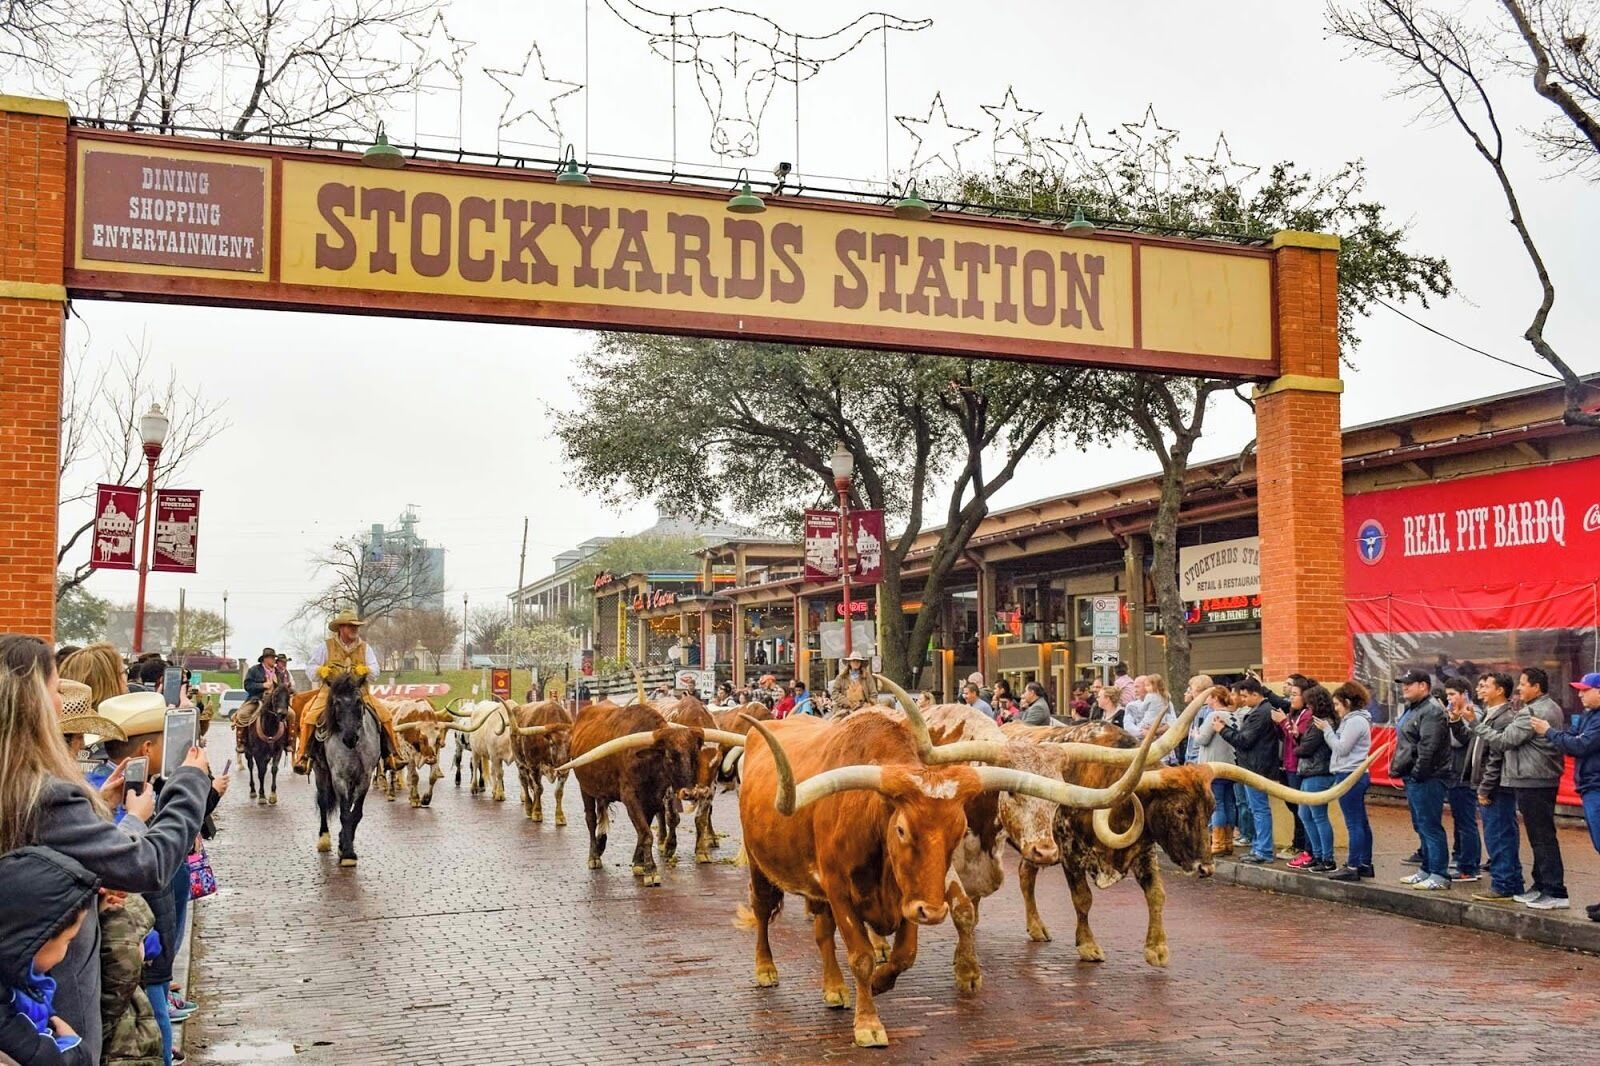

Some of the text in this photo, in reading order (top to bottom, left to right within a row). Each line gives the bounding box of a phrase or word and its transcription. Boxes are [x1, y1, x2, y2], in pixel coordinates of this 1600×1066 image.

[142, 167, 210, 195] DINING
[129, 196, 221, 226] SHOPPING
[92, 224, 255, 259] ENTERTAINMENT
[315, 182, 1105, 331] STOCKYARDS STATION
[1403, 512, 1450, 557] REAL
[1456, 507, 1489, 552] PIT
[1184, 547, 1238, 586] STOCKYARDS
[1197, 581, 1216, 591] RETAIL
[369, 683, 441, 696] WIFT
[703, 673, 713, 681] ONE
